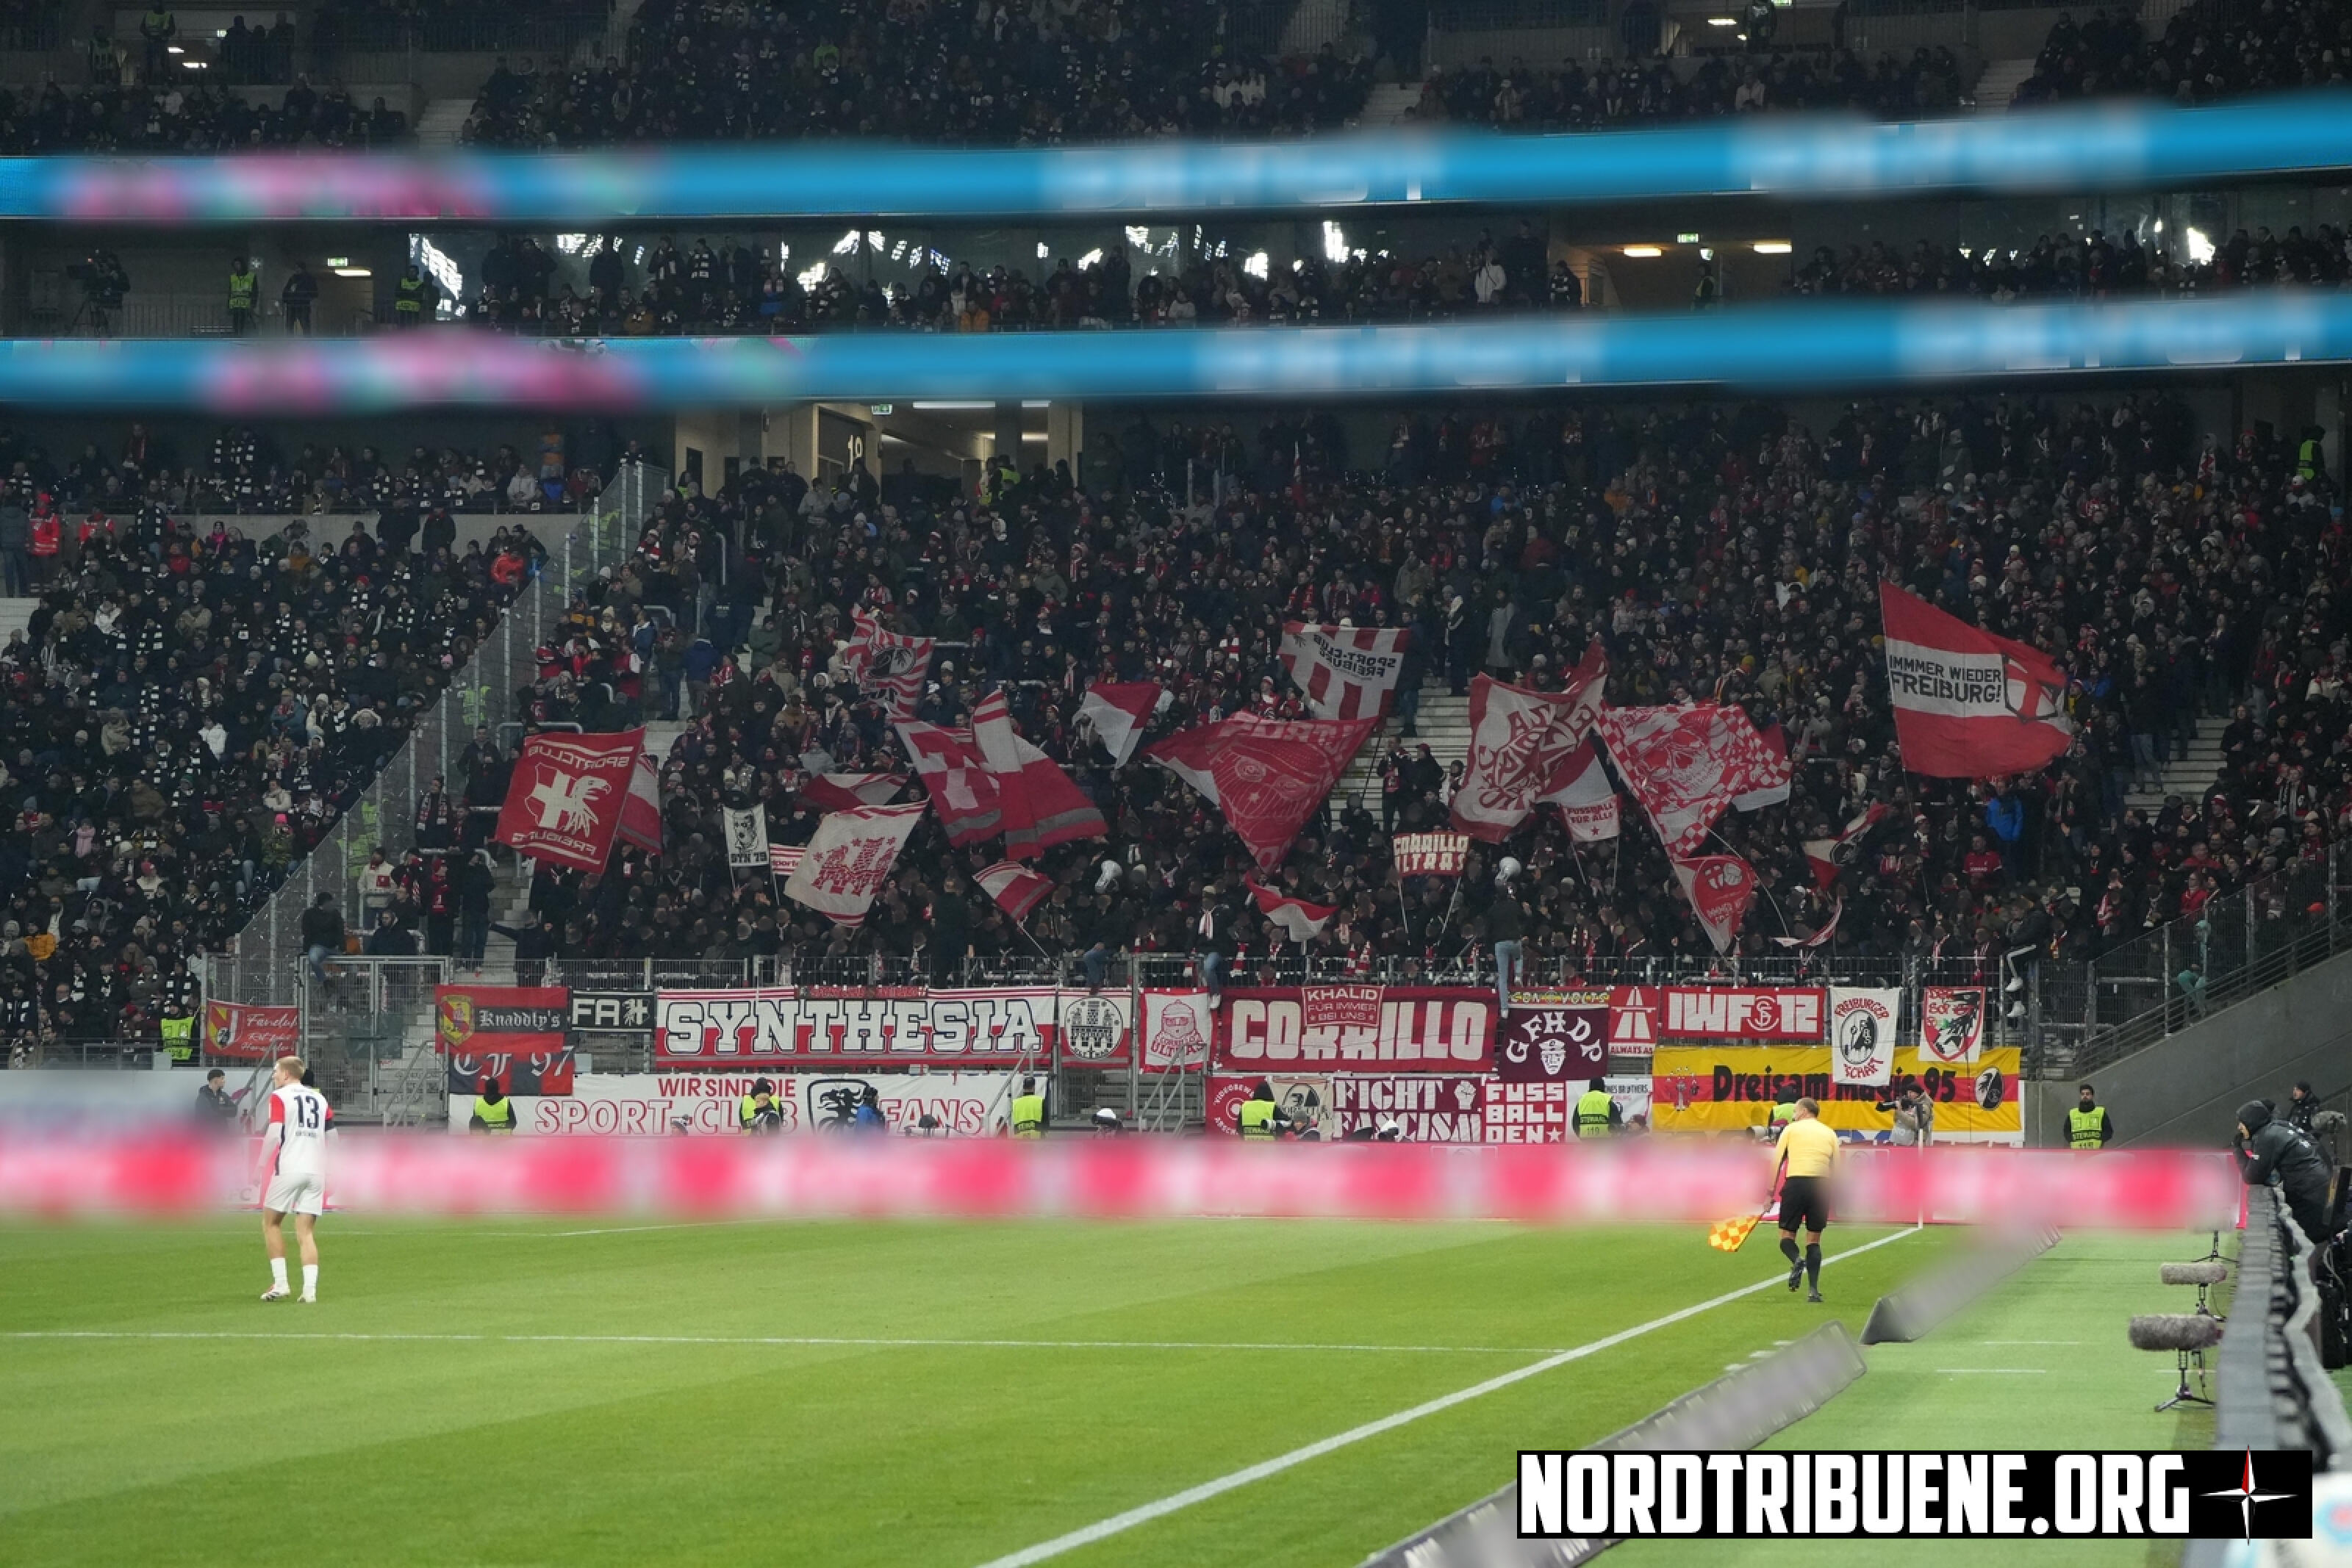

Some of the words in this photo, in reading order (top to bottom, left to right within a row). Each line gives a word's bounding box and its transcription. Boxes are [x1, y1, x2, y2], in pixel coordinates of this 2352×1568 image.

[1948, 666, 2001, 683] WIEDER
[1890, 670, 2001, 703] FREIBURG!
[1394, 833, 1469, 857] CORRILLO
[1307, 985, 1378, 1001] KHALID
[1308, 1001, 1334, 1012] FÜR
[1335, 1002, 1377, 1012] IMMER
[1318, 1013, 1337, 1021] BEI
[1340, 1012, 1366, 1021] UNS
[1835, 998, 1890, 1019] FREIBURGER
[478, 1010, 562, 1030] Knaddly's
[666, 999, 1044, 1055] SYNTHESIA
[1230, 1000, 1488, 1060] CORRILLO
[1151, 1040, 1204, 1057] ULTAS
[531, 1045, 575, 1076] 97
[659, 1079, 700, 1097] WIR
[704, 1079, 755, 1097] SIND
[1335, 1080, 1444, 1110] FIGHT
[1485, 1083, 1566, 1101] FUSS
[1713, 1065, 1829, 1102] Dreisam
[1923, 1067, 1956, 1104] 95
[293, 1094, 320, 1129] 13
[535, 1099, 799, 1137] SPORT-CLB
[879, 1099, 985, 1136] FANS
[1485, 1104, 1563, 1123] BALL
[1485, 1125, 1545, 1144] DEN
